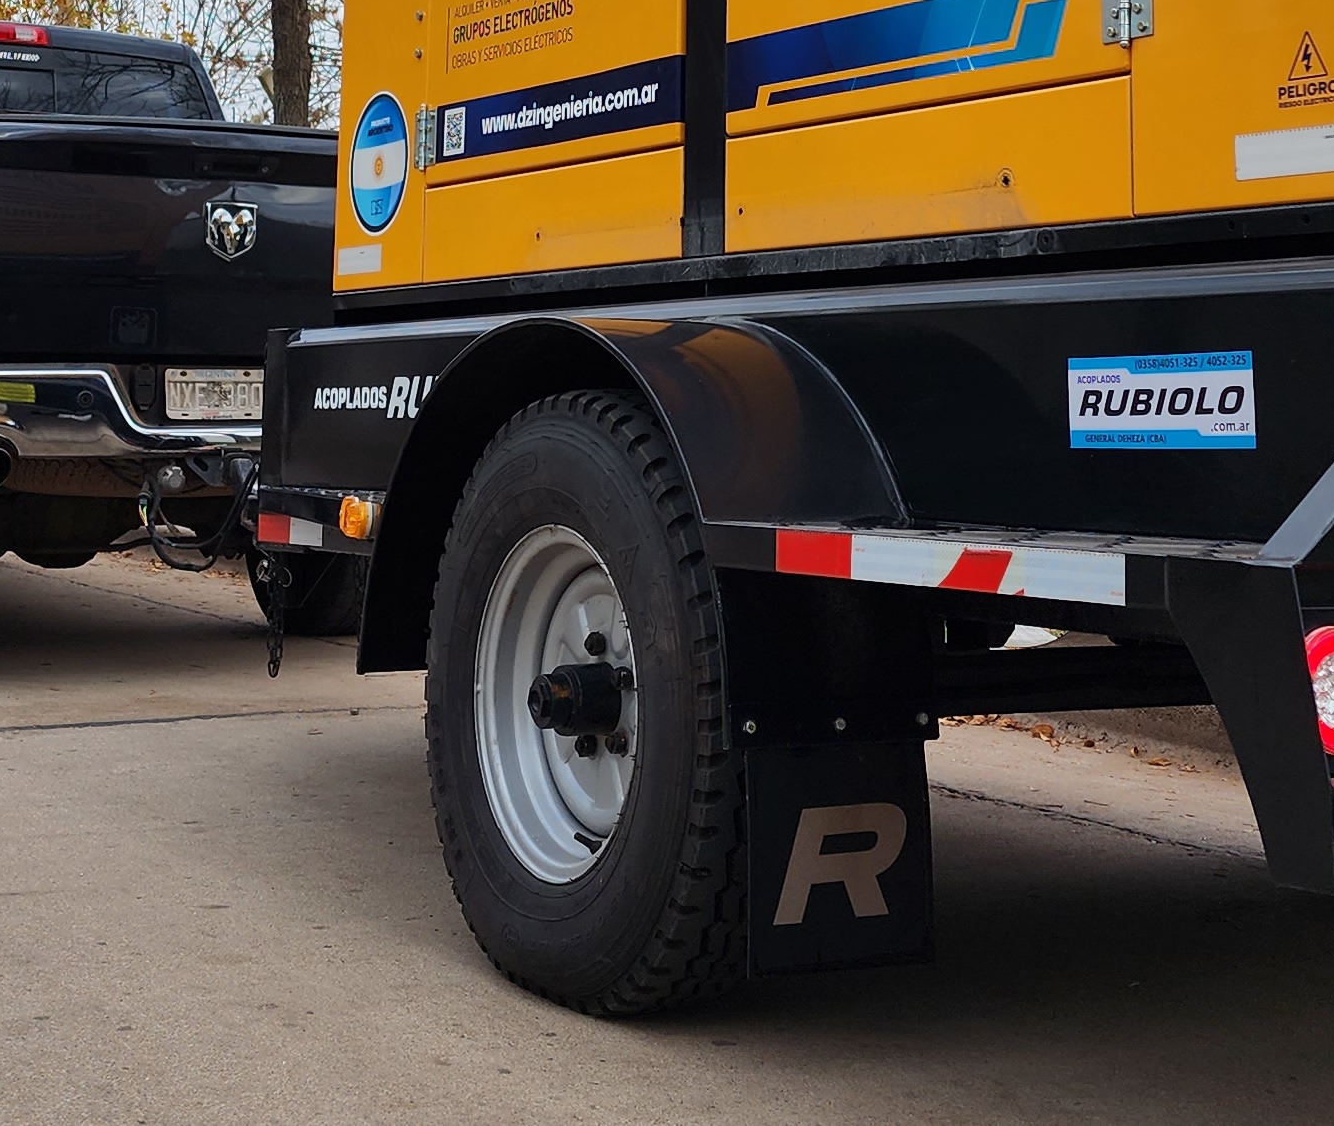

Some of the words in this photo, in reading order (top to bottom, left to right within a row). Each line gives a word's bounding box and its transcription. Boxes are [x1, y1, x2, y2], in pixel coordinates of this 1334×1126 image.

[454, 0, 485, 18] ALQUILER
[453, 18, 491, 44] GRUPOS
[452, 51, 476, 69] OBRAS
[483, 39, 522, 62] SERVICIOS
[524, 27, 574, 53] ELÉCTRICOS
[481, 82, 659, 135] www.dzingenieria.com.ar
[1278, 100, 1302, 109] RIESGO
[1077, 374, 1121, 384] ACOPLADOS
[314, 386, 387, 410] ACOPLADOS
[386, 375, 439, 419] RU
[1079, 385, 1245, 416] RUBIOLO
[1085, 434, 1116, 443] GENERAL
[1118, 434, 1145, 443] DEHEZA
[1210, 421, 1250, 432] .com.ar
[772, 803, 908, 926] R
